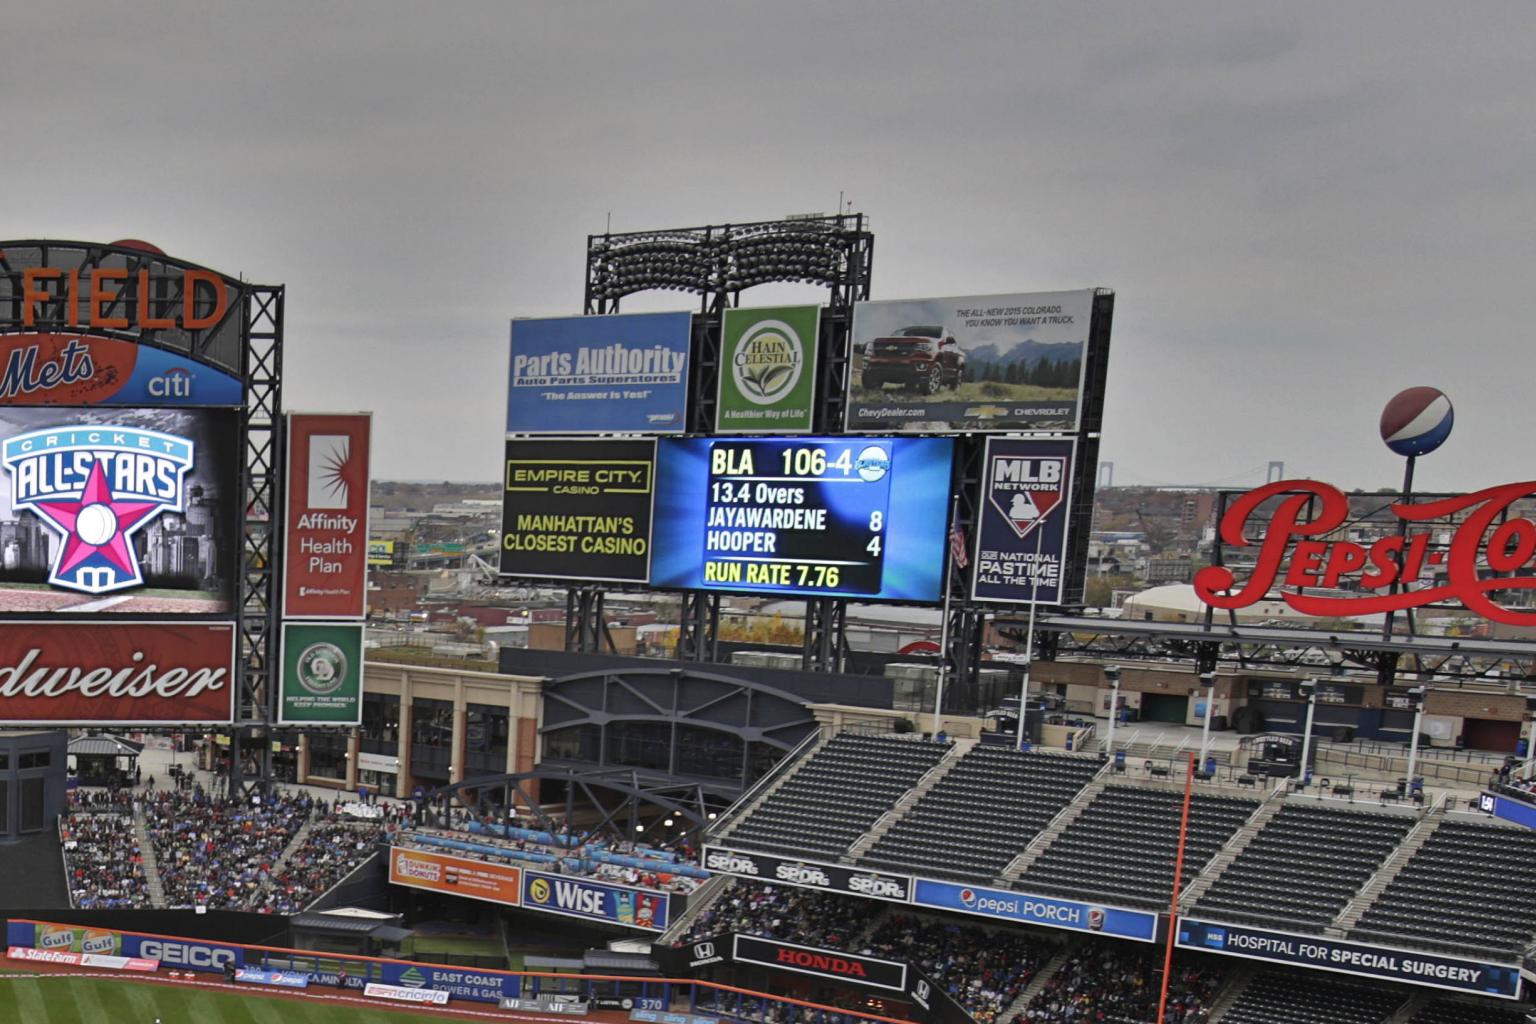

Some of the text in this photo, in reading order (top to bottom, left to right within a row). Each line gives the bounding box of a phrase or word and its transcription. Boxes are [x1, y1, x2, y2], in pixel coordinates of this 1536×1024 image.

[23, 267, 228, 328] FIELD
[957, 307, 1021, 317] THE ALL-NEW 2015
[965, 319, 979, 328] YOU
[980, 318, 1003, 327] KNOW
[1004, 318, 1018, 326] YOU
[1019, 317, 1041, 325] WANT
[1042, 316, 1048, 324] A
[751, 341, 786, 354] HAIN
[514, 343, 685, 377] Parts Authority
[735, 351, 801, 366] CELESTIAL
[148, 372, 191, 397] citi
[516, 375, 677, 386] Auto Parts Superstores
[567, 391, 608, 400] Answer
[724, 409, 789, 419] A Healthier Way of
[859, 407, 925, 419] ChevyDealer.com
[1014, 407, 1070, 416] CHEVROLET
[21, 432, 176, 453] CRICKET
[711, 449, 754, 475] BLA
[782, 449, 852, 475] 106-4
[514, 470, 590, 482] EMPIRE
[994, 460, 1062, 483] MLB
[553, 485, 600, 494] CASINO
[711, 483, 804, 504] 13.4 Overs
[994, 482, 1059, 491] NETWORK
[297, 514, 357, 534] Affinity
[517, 515, 634, 535] MANHATTAN'S
[707, 507, 883, 531] JAYAWARDENE 8
[300, 537, 352, 554] Health
[503, 534, 646, 556] CLOSEST CASINO
[707, 531, 881, 557] HOOPER 4
[309, 556, 342, 573] Plan
[1000, 552, 1059, 563] NATIONAL
[705, 562, 839, 587] RUN RATE 7.76
[979, 561, 1059, 577] PASTIME
[978, 574, 1057, 587] ALL THE TIME
[555, 881, 607, 915] WISE
[978, 898, 1080, 923] pepsi PORCH
[42, 934, 71, 947] Gulf
[83, 938, 113, 951] Gulf
[140, 941, 236, 968] GEICO
[776, 948, 866, 976] HONDA
[1207, 932, 1481, 984] HSS HOSPITAL FOR SPECIAL SURGERY
[432, 972, 504, 987] EAST COAST
[432, 985, 503, 999] POWER & GAS
[642, 999, 662, 1010] 370
